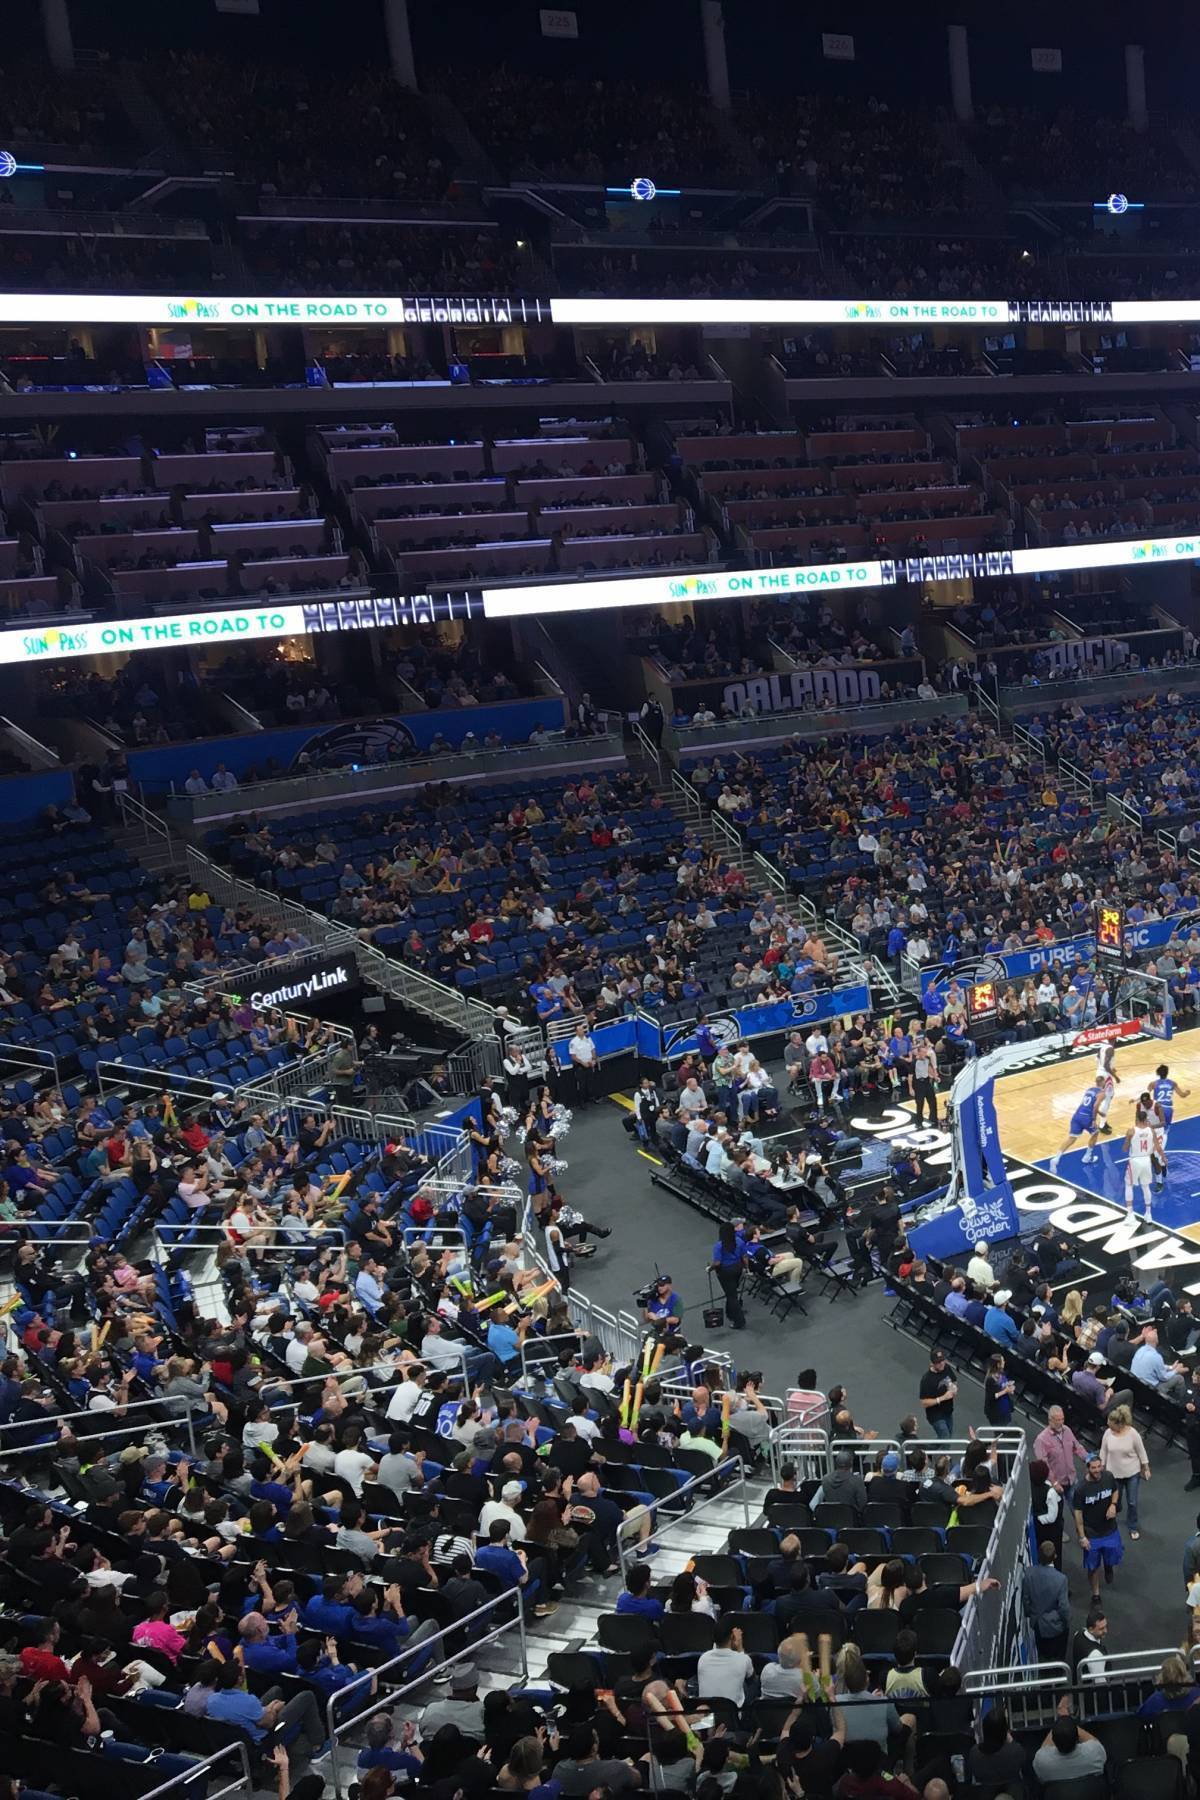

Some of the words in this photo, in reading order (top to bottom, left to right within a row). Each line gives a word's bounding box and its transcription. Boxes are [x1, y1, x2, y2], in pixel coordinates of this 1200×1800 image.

[231, 303, 259, 316] ON
[265, 303, 300, 316] THE
[306, 303, 358, 316] ROAD
[363, 303, 388, 316] TO
[889, 306, 910, 317] ON
[914, 306, 938, 317] THE
[941, 305, 977, 317] ROAD
[981, 305, 998, 316] TO
[1176, 543, 1194, 553] ON
[728, 578, 753, 590] ON
[758, 574, 790, 588] THE
[796, 570, 841, 584] ROAD
[846, 568, 867, 581] TO
[102, 628, 134, 645] ON
[142, 621, 182, 640] THE
[189, 616, 250, 636] ROAD
[258, 614, 285, 630] TO
[1101, 922, 1118, 944] 24
[1029, 945, 1075, 970] PURE
[251, 966, 348, 1011] CenturyLink
[1158, 1090, 1173, 1102] 25
[977, 1095, 988, 1148] AdventHealth
[1140, 1139, 1148, 1152] 14
[959, 1214, 991, 1230] Olive
[966, 1221, 1011, 1243] Garden
